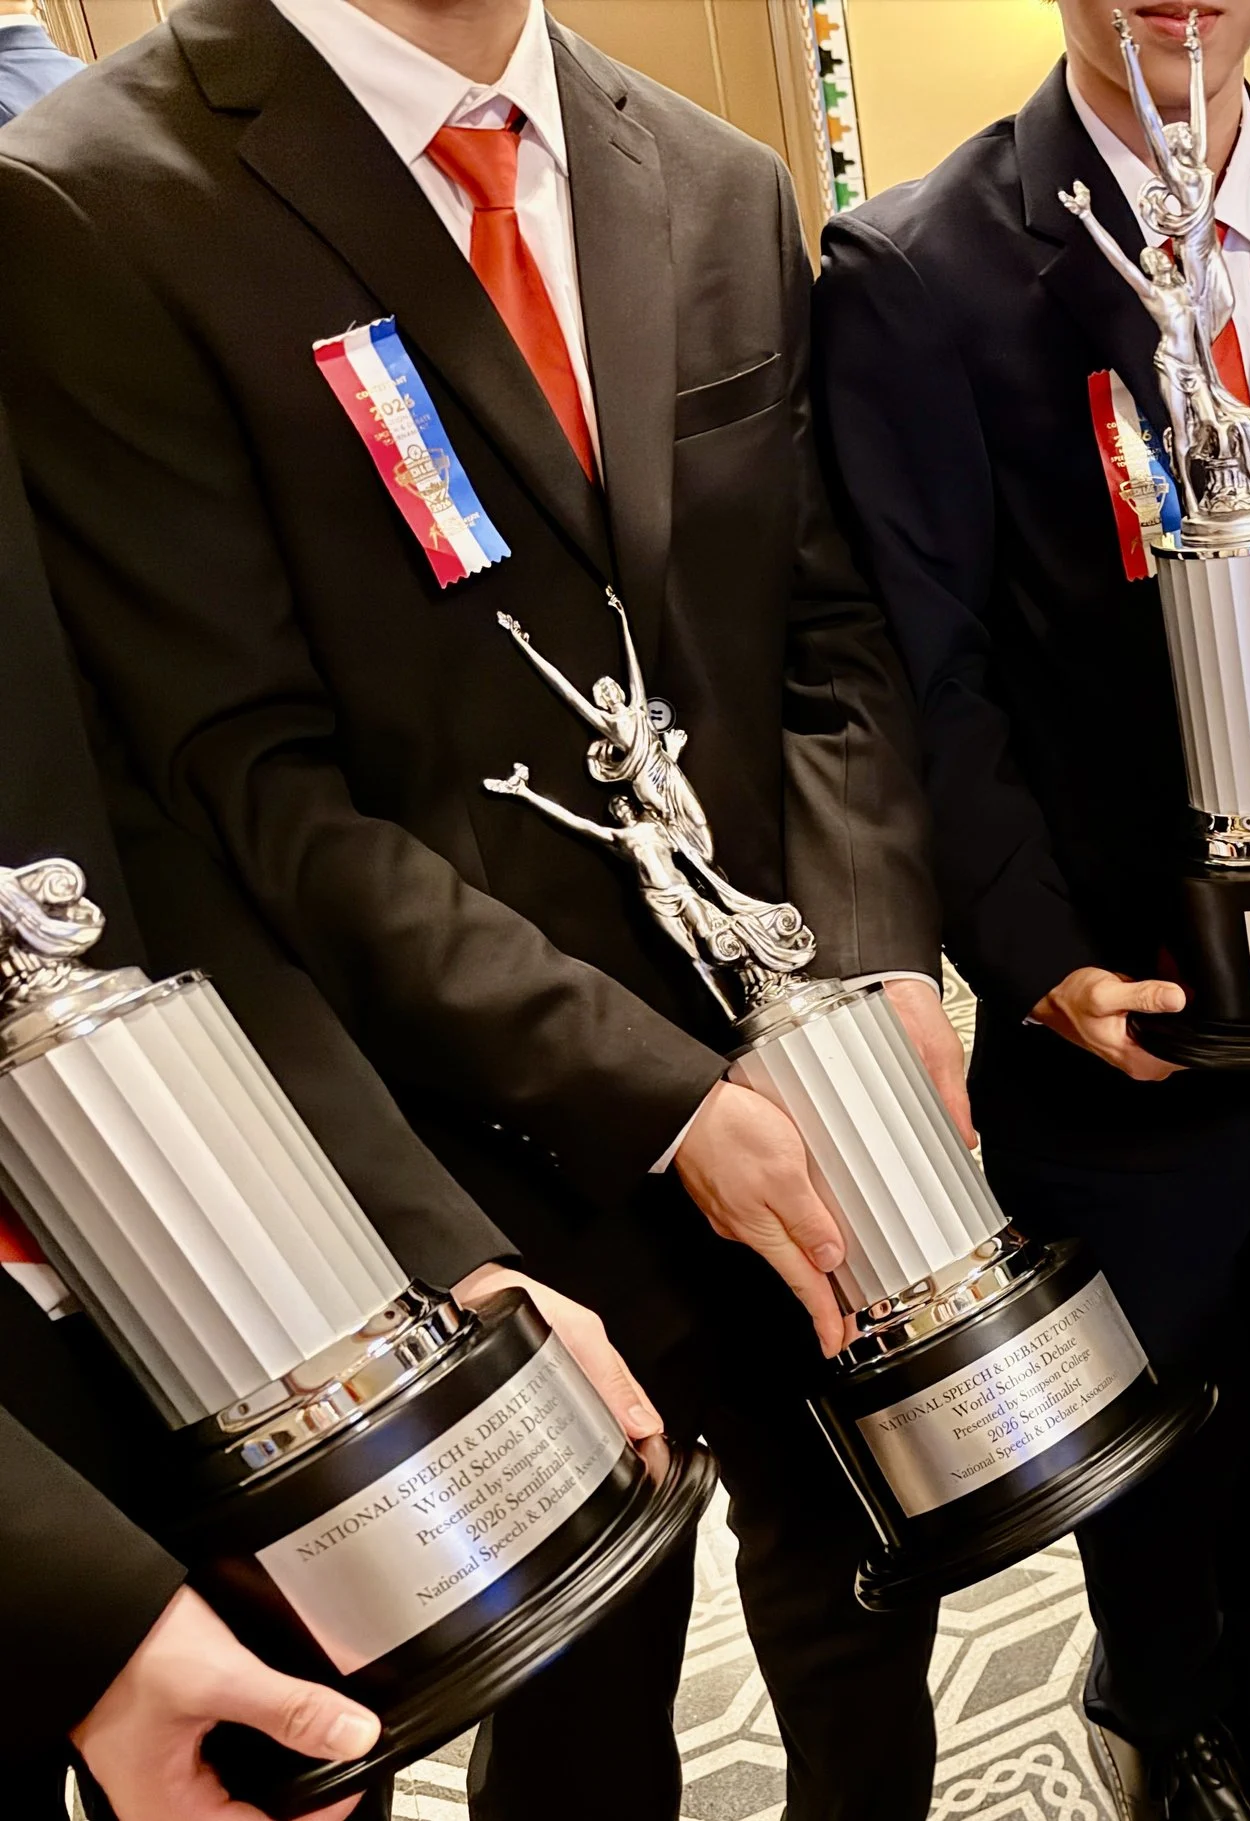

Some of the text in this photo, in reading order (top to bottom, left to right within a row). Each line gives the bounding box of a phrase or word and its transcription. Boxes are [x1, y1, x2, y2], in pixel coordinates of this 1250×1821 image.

[878, 1398, 944, 1432] NATIONAL
[942, 1368, 993, 1404] SPEECH
[992, 1362, 1005, 1375] &
[1003, 1330, 1053, 1368] DEBATE
[951, 1337, 1078, 1418] World Schools Debate
[952, 1348, 1092, 1441] Presented by Simpson College
[987, 1377, 1083, 1443] 2026 Semifinalist
[296, 1495, 400, 1562] NATIONAL
[397, 1444, 466, 1499] SPEECH
[464, 1436, 480, 1452] &
[476, 1388, 532, 1441] DEBATE
[412, 1469, 473, 1516] World
[470, 1429, 525, 1478] Schools
[950, 1452, 996, 1483] National
[995, 1431, 1035, 1460] Speech
[1034, 1424, 1046, 1437] &
[1044, 1401, 1080, 1429] Debate
[415, 1485, 488, 1547] Presented
[483, 1478, 504, 1497] by
[501, 1438, 550, 1483] Simpson
[415, 1474, 578, 1607] National Speech & Debate
[465, 1502, 507, 1543] 2026
[504, 1444, 576, 1511] Semifinalist
